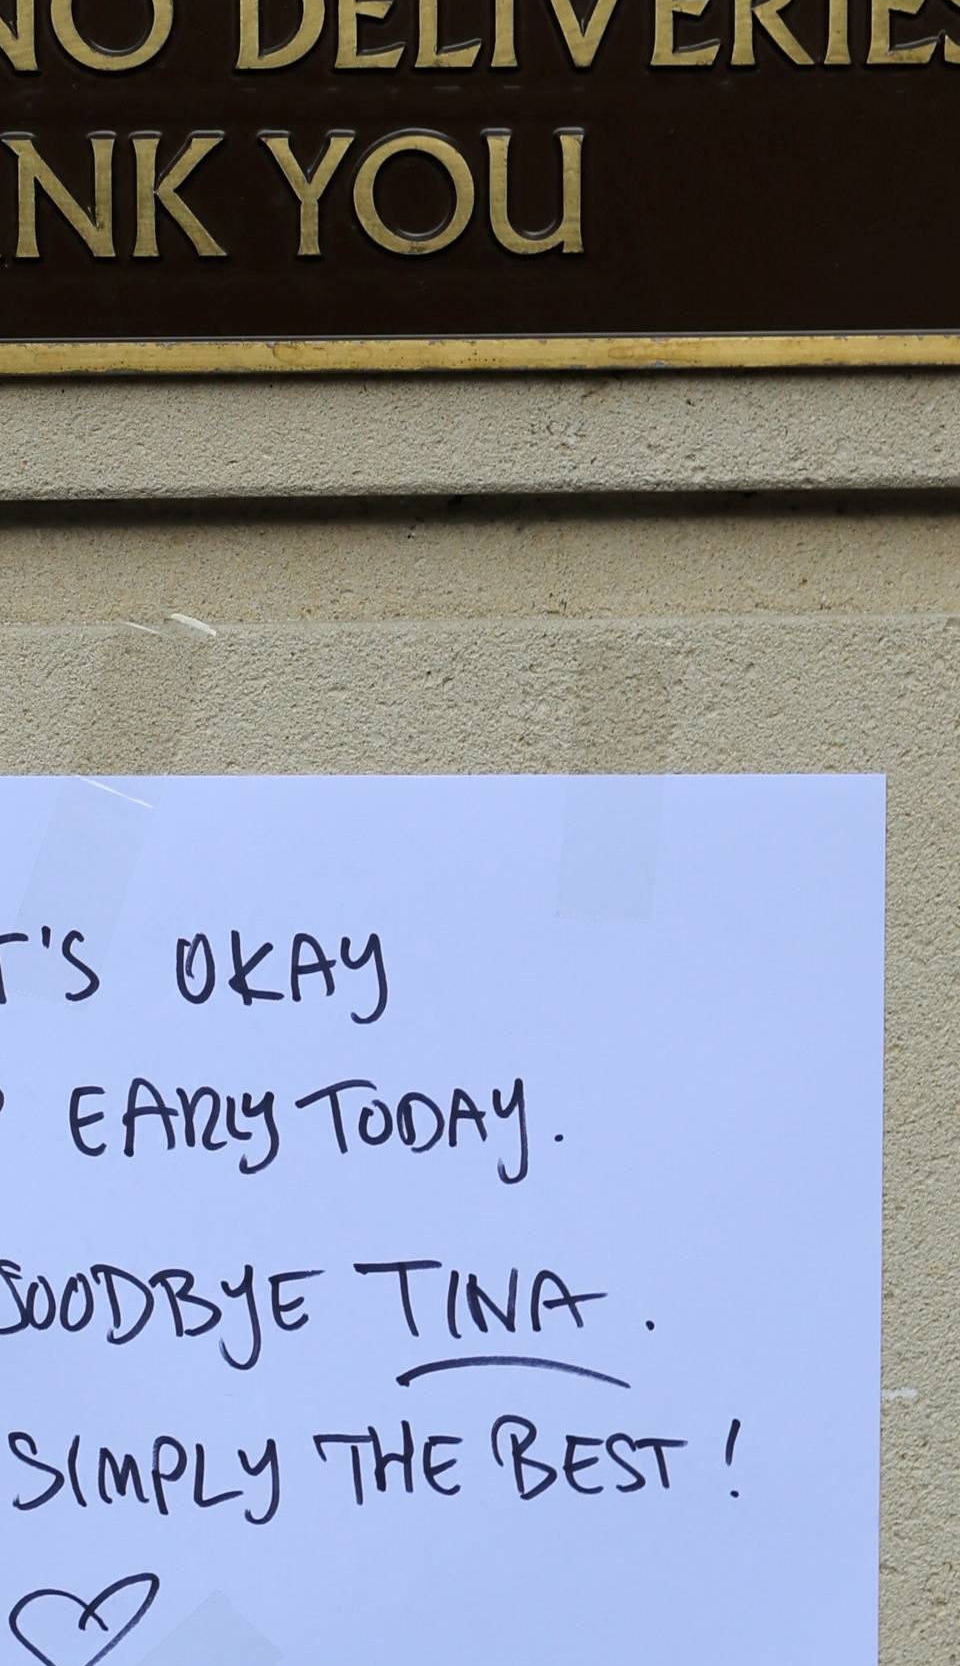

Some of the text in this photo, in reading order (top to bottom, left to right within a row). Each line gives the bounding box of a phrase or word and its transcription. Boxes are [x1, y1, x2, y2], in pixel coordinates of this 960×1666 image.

[262, 135, 585, 256] YOU
[176, 930, 388, 1025] OKAY
[8, 1432, 280, 1525] SIMPLY
[313, 1420, 464, 1506] THE
